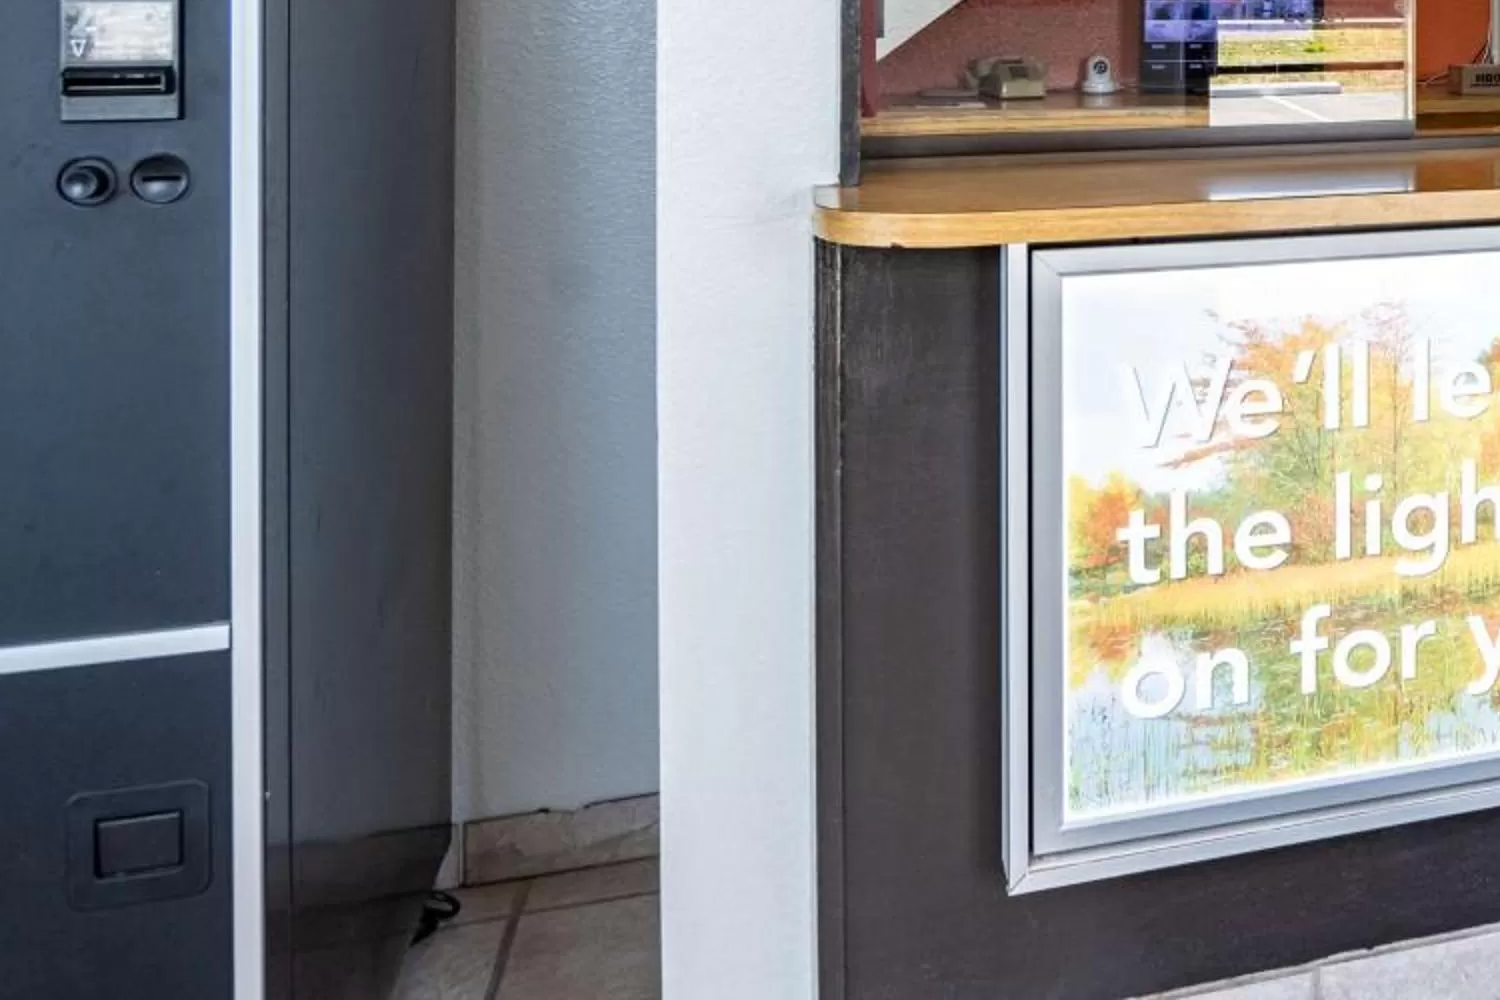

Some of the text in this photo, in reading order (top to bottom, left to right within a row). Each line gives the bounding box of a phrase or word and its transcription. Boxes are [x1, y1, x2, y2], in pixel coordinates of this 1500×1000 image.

[1121, 339, 1370, 449] We'll
[1117, 490, 1291, 585] the
[1120, 640, 1250, 719] on
[1290, 604, 1437, 695] for
